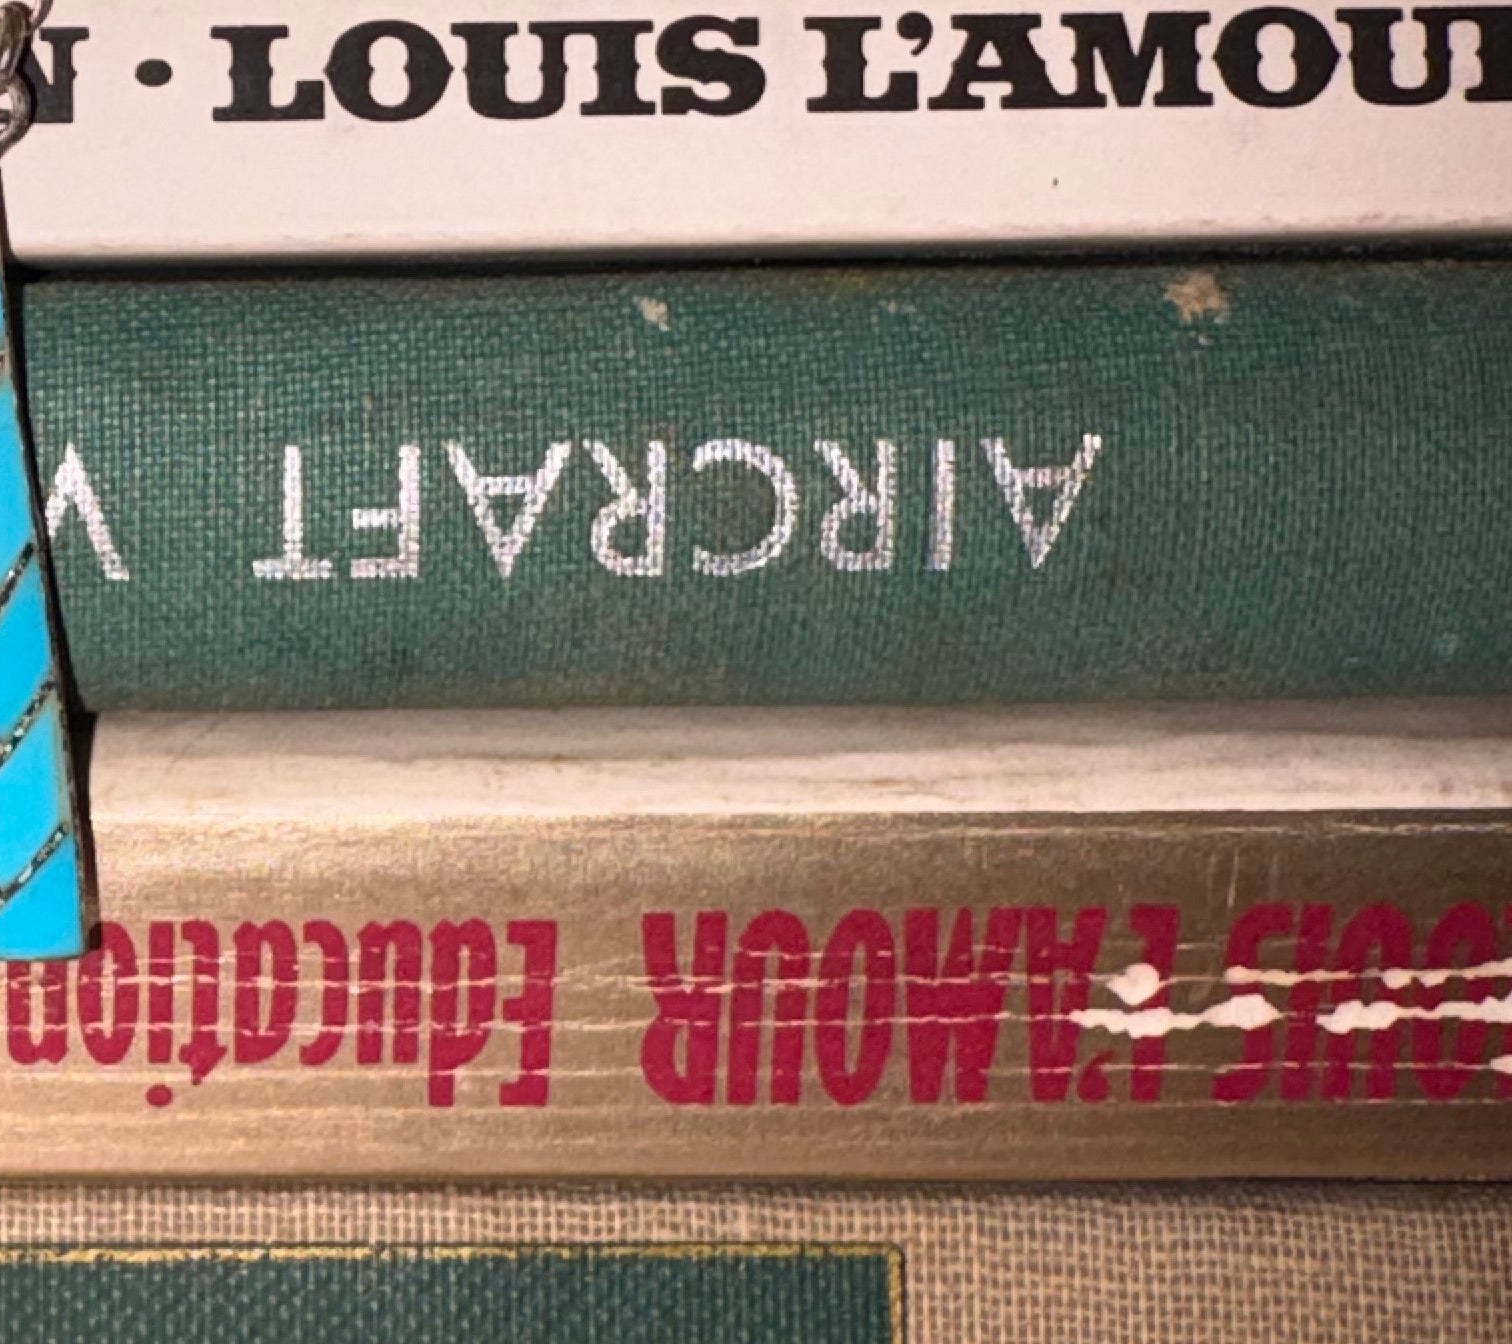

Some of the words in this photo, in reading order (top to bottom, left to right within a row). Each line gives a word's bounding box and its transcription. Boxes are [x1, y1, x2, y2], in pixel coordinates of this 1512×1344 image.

[209, 14, 768, 123] LOUIS
[252, 433, 1102, 579] AIRCRAFT
[6, 918, 558, 1108] Education
[1211, 900, 1512, 1105] OUIS
